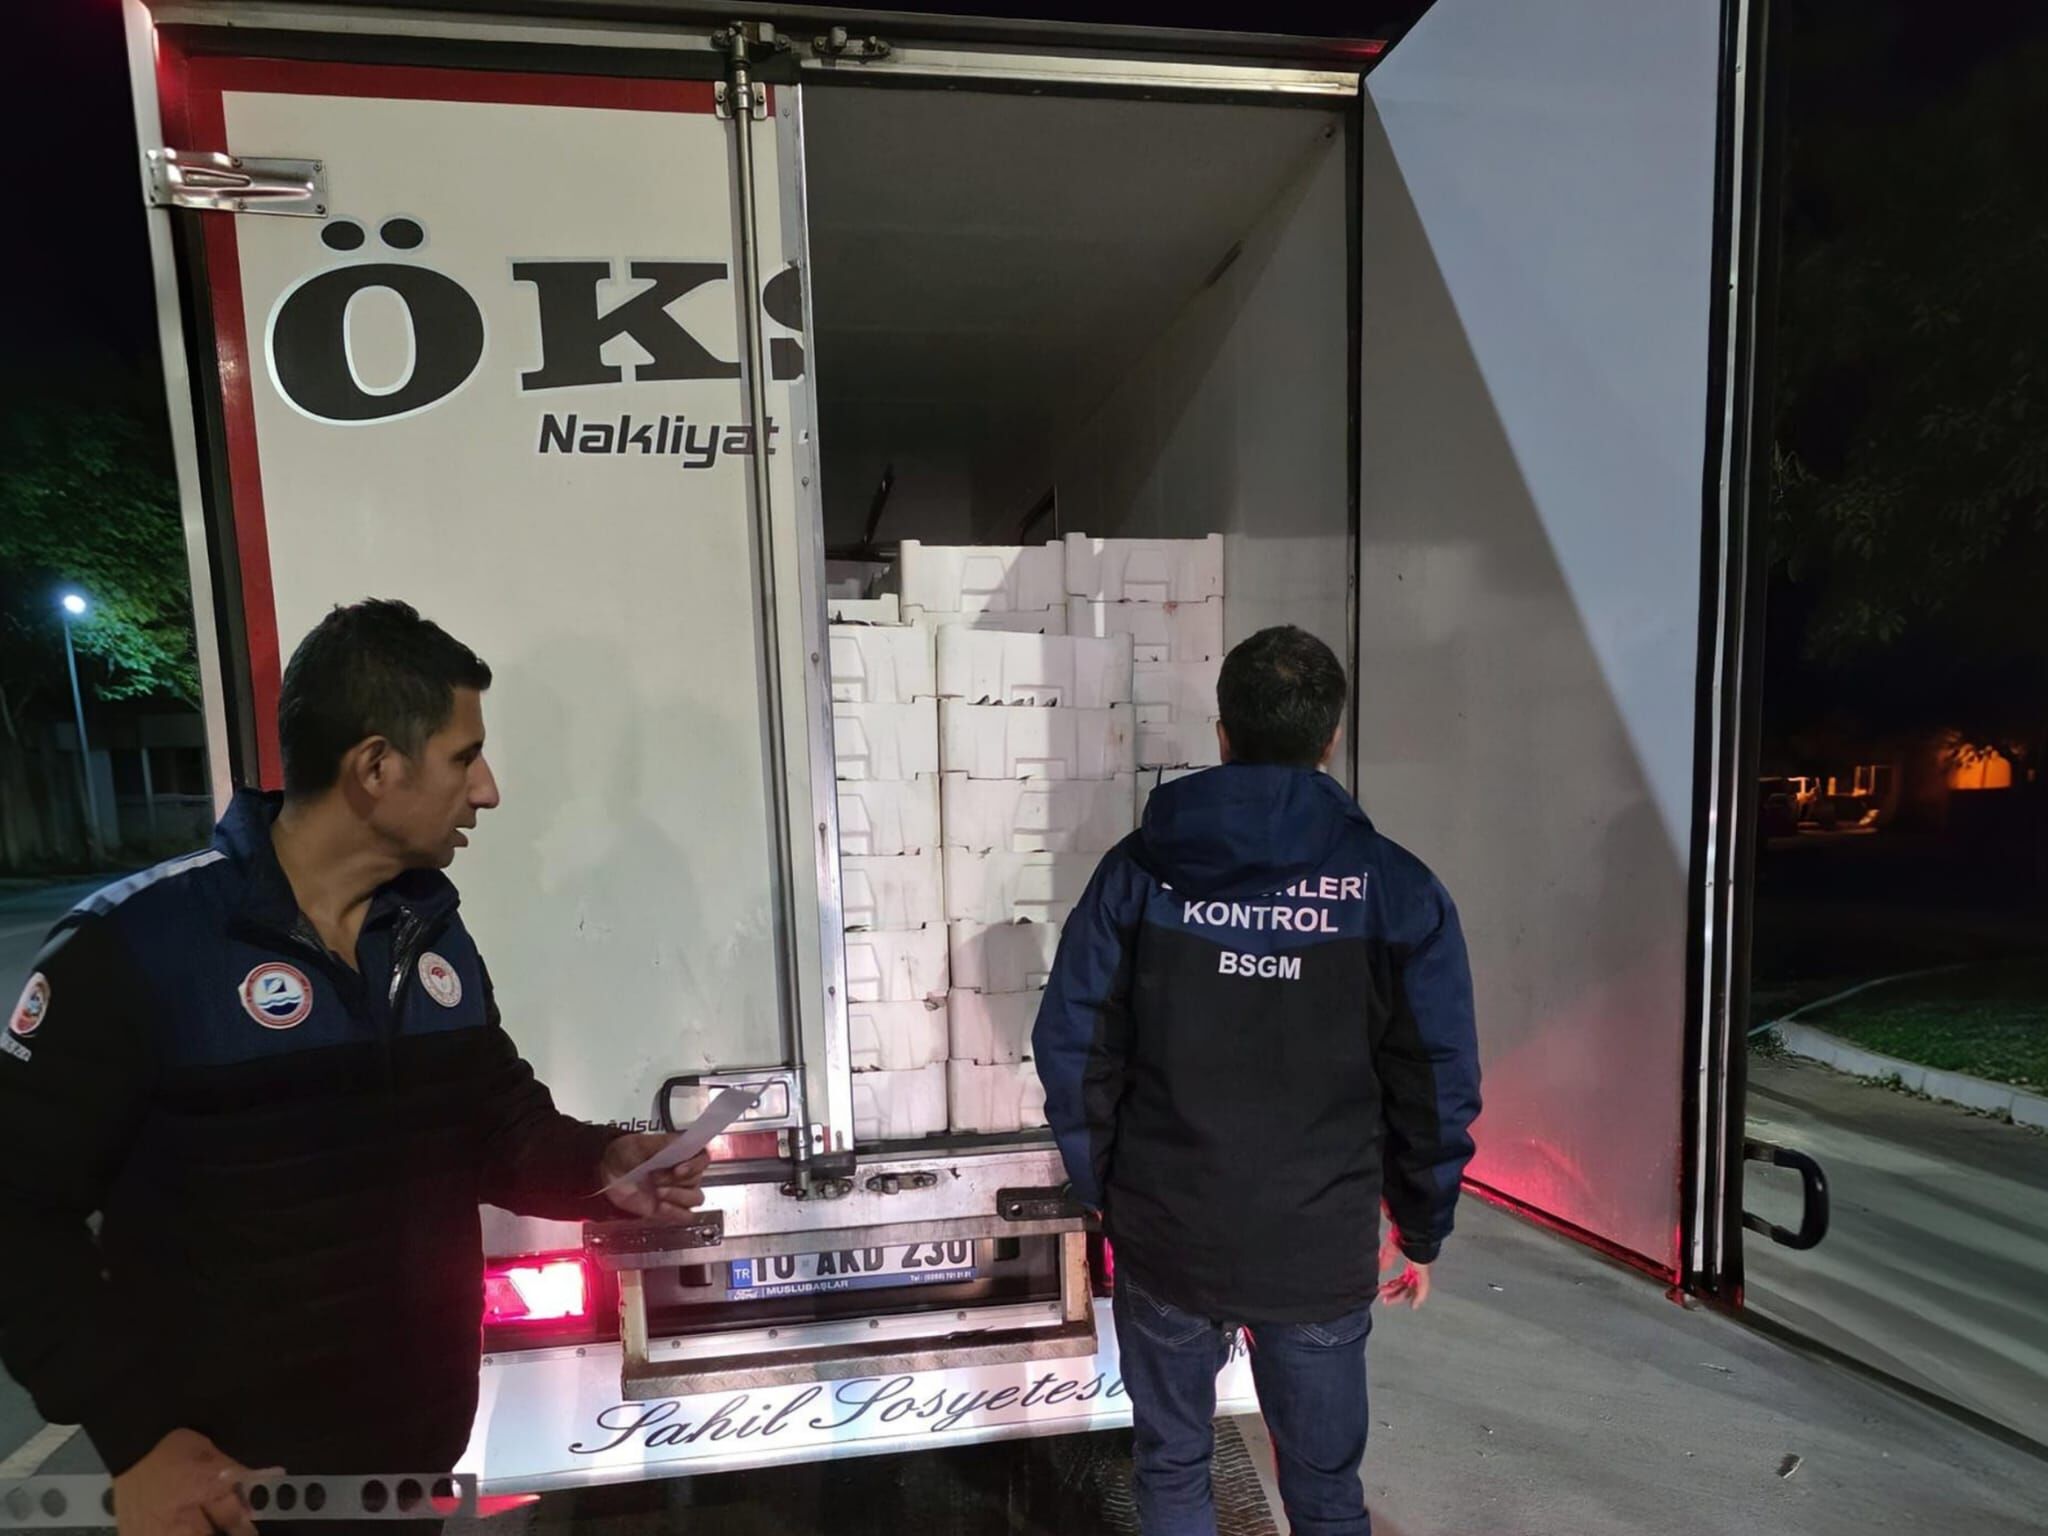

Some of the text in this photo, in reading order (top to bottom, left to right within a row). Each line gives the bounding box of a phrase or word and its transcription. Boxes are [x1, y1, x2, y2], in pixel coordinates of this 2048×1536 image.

[538, 413, 779, 469] Nakliyat
[1287, 872, 1368, 900] LERİ
[1183, 900, 1339, 933] KONTROL
[1218, 951, 1302, 980] BSGM
[734, 1268, 751, 1280] TR
[816, 1246, 884, 1276] AKD
[901, 1239, 967, 1269] 230
[568, 1385, 823, 1455] Sahil
